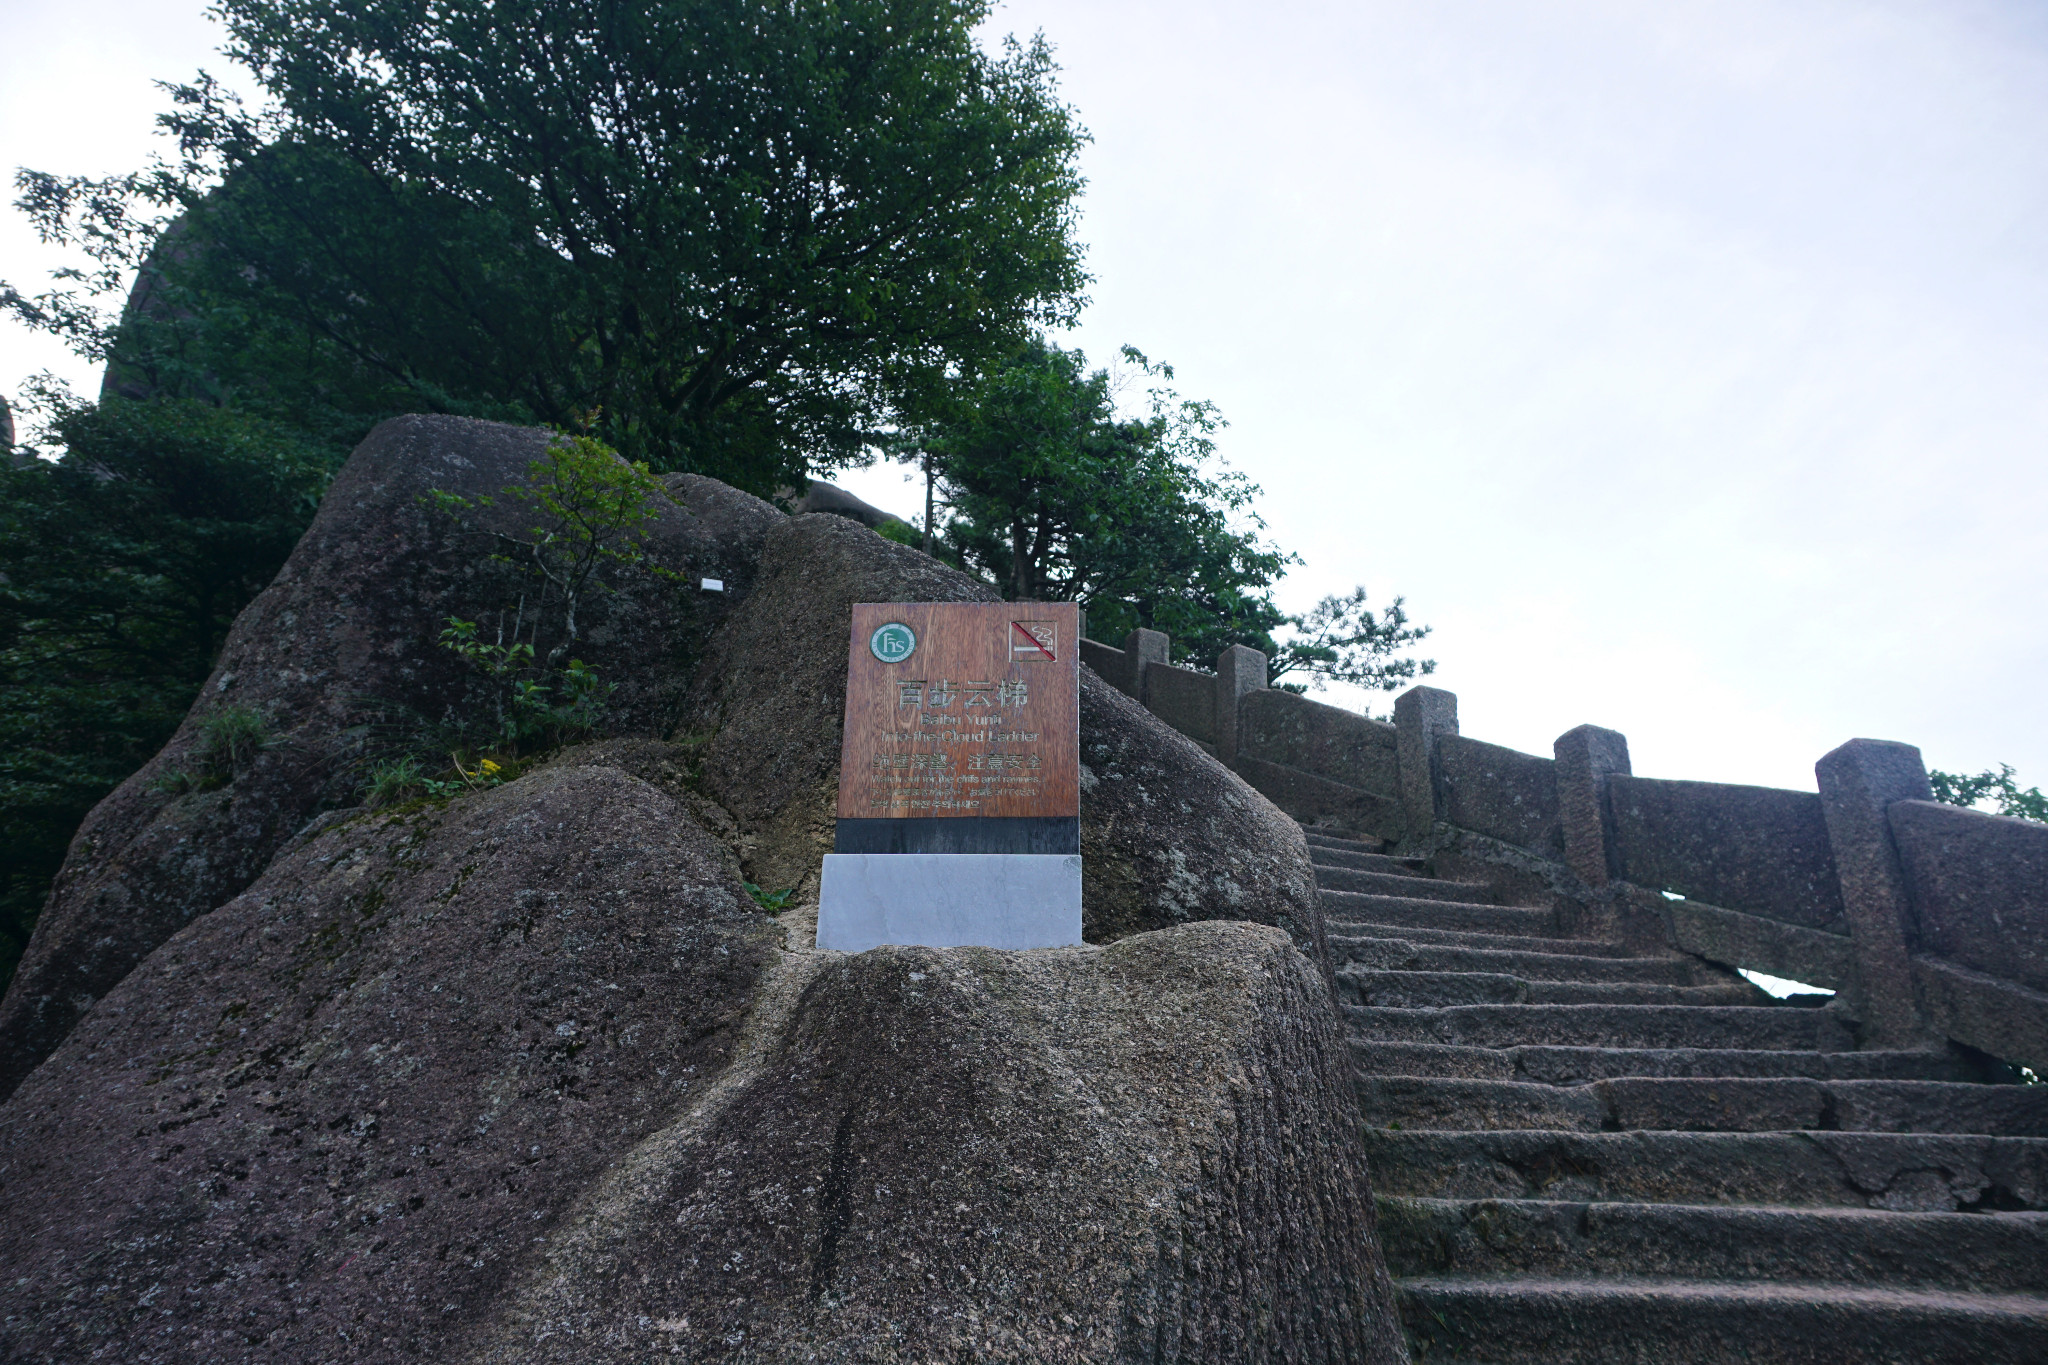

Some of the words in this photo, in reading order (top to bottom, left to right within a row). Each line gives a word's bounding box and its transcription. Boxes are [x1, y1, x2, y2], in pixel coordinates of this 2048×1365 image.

[896, 678, 1028, 710] 百步云梯
[920, 712, 961, 725] Baibu
[988, 730, 1039, 742] Ladder
[871, 774, 902, 783] Watch
[938, 774, 955, 783] the
[981, 774, 1001, 783] and
